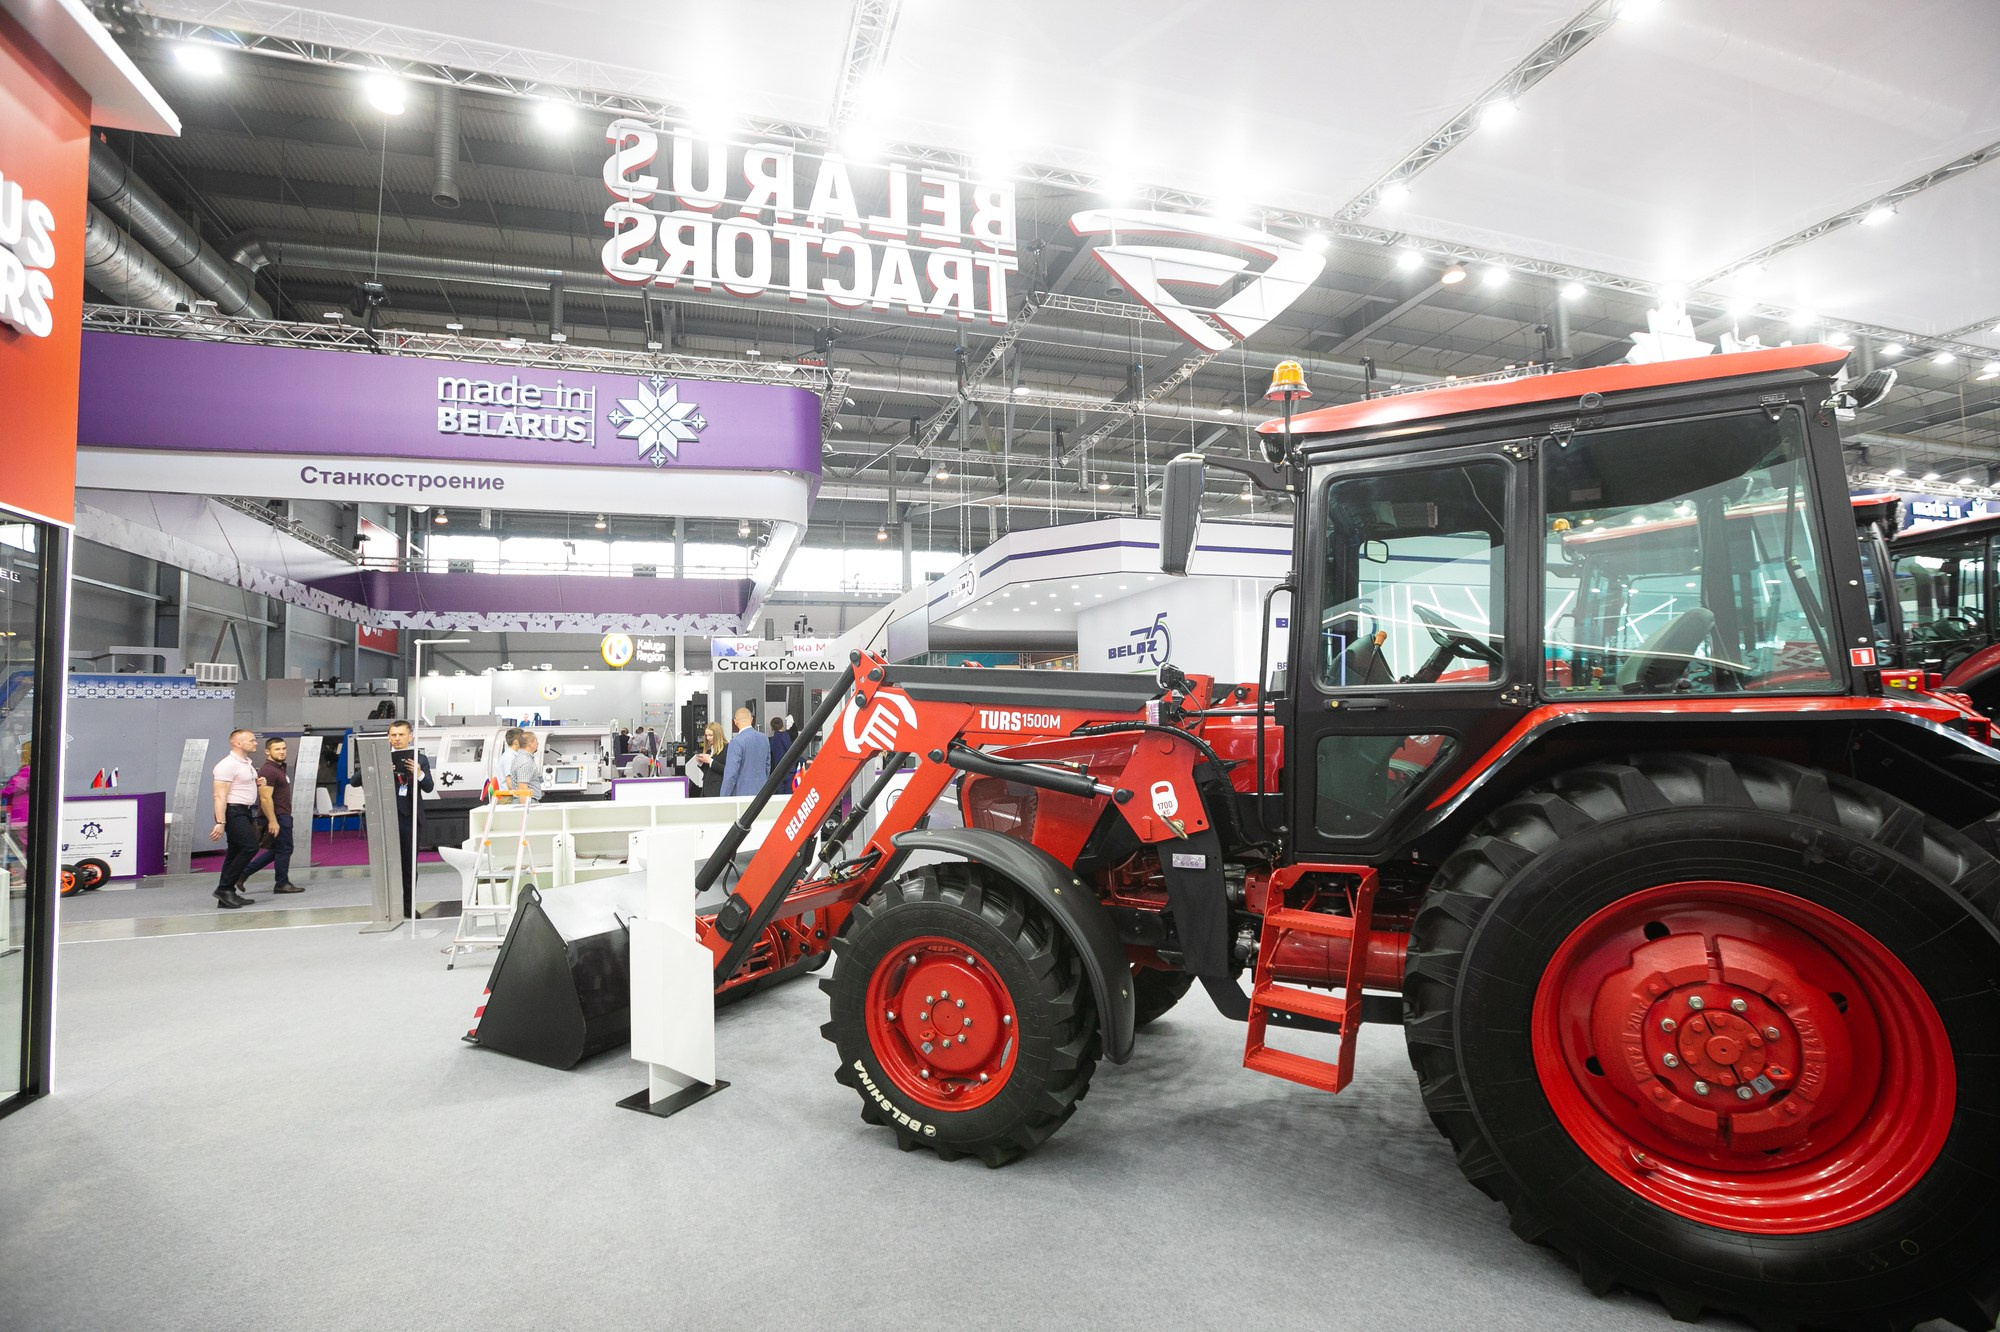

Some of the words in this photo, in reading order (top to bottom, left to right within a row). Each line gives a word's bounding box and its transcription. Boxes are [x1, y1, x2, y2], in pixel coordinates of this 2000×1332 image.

[437, 375, 542, 408] made
[556, 379, 587, 412] in
[437, 406, 587, 442] BELARUS
[300, 465, 505, 492] Станкостроение
[636, 638, 667, 653] Kaluga
[636, 649, 666, 664] Region
[1107, 639, 1158, 660] BELAZ
[717, 657, 836, 671] СтанкоГомель
[979, 709, 1022, 732] TURS
[1022, 712, 1061, 730] 1500M
[784, 787, 820, 842] BELARUS
[1157, 800, 1173, 811] 1700
[853, 1059, 922, 1133] BELSHINA
